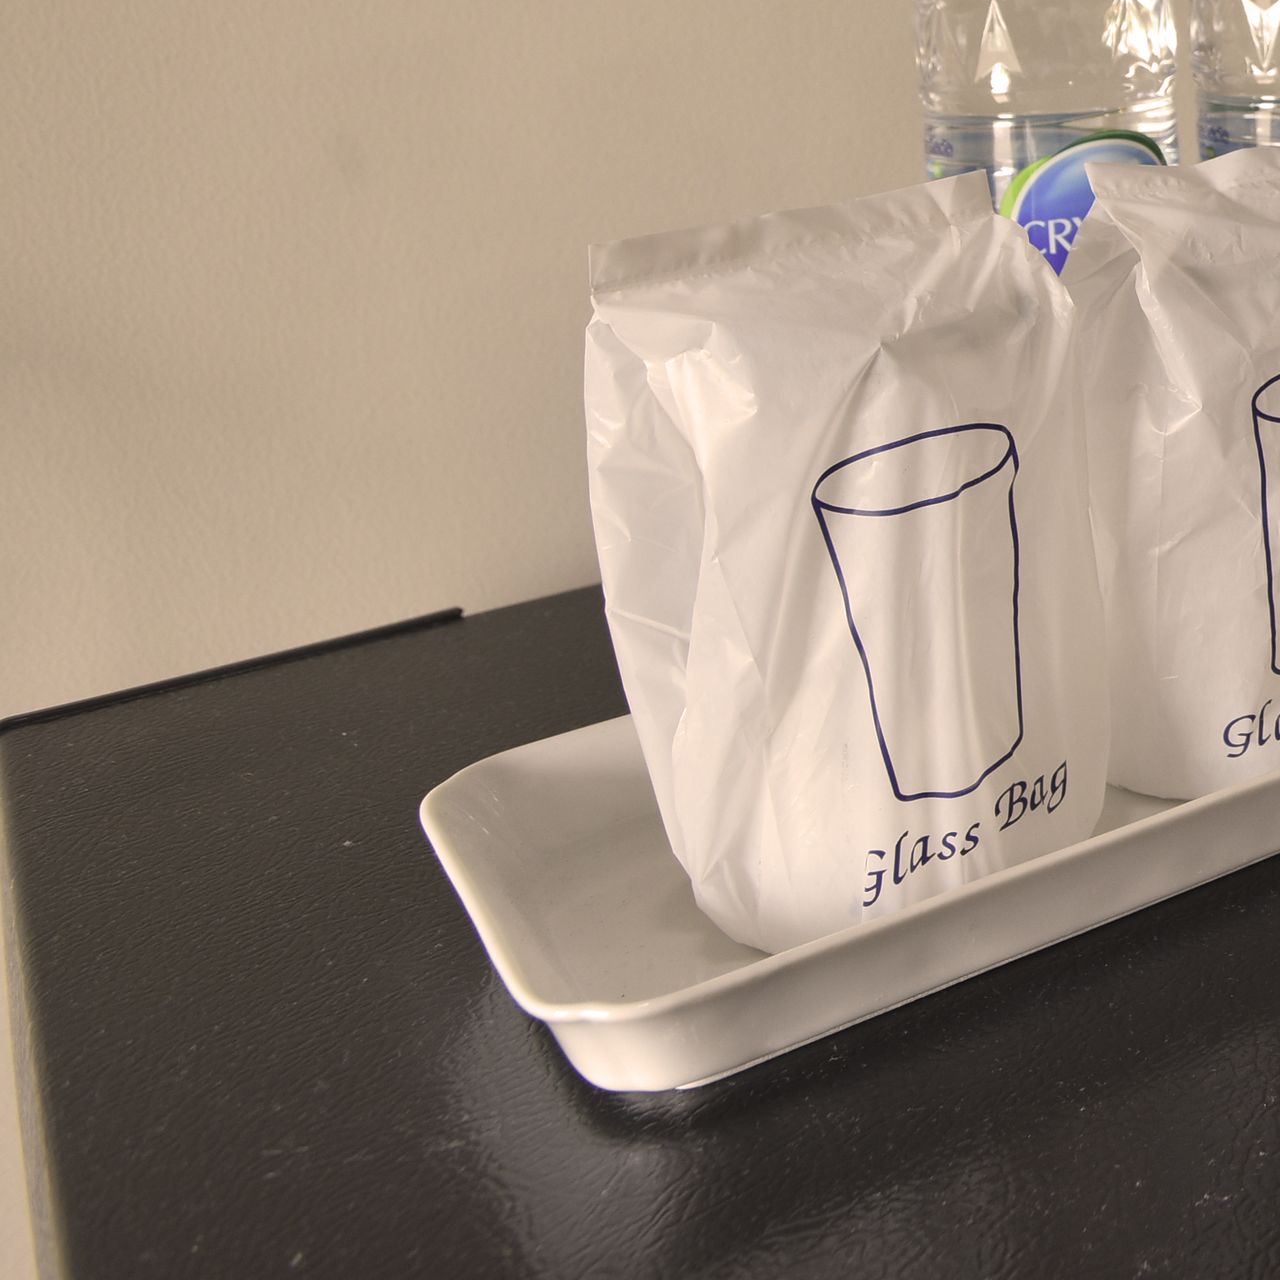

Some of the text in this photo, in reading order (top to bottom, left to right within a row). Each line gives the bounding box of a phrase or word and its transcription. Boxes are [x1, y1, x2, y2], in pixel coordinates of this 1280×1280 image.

[1023, 217, 1082, 255] CR
[862, 759, 1068, 908] Glass Bag
